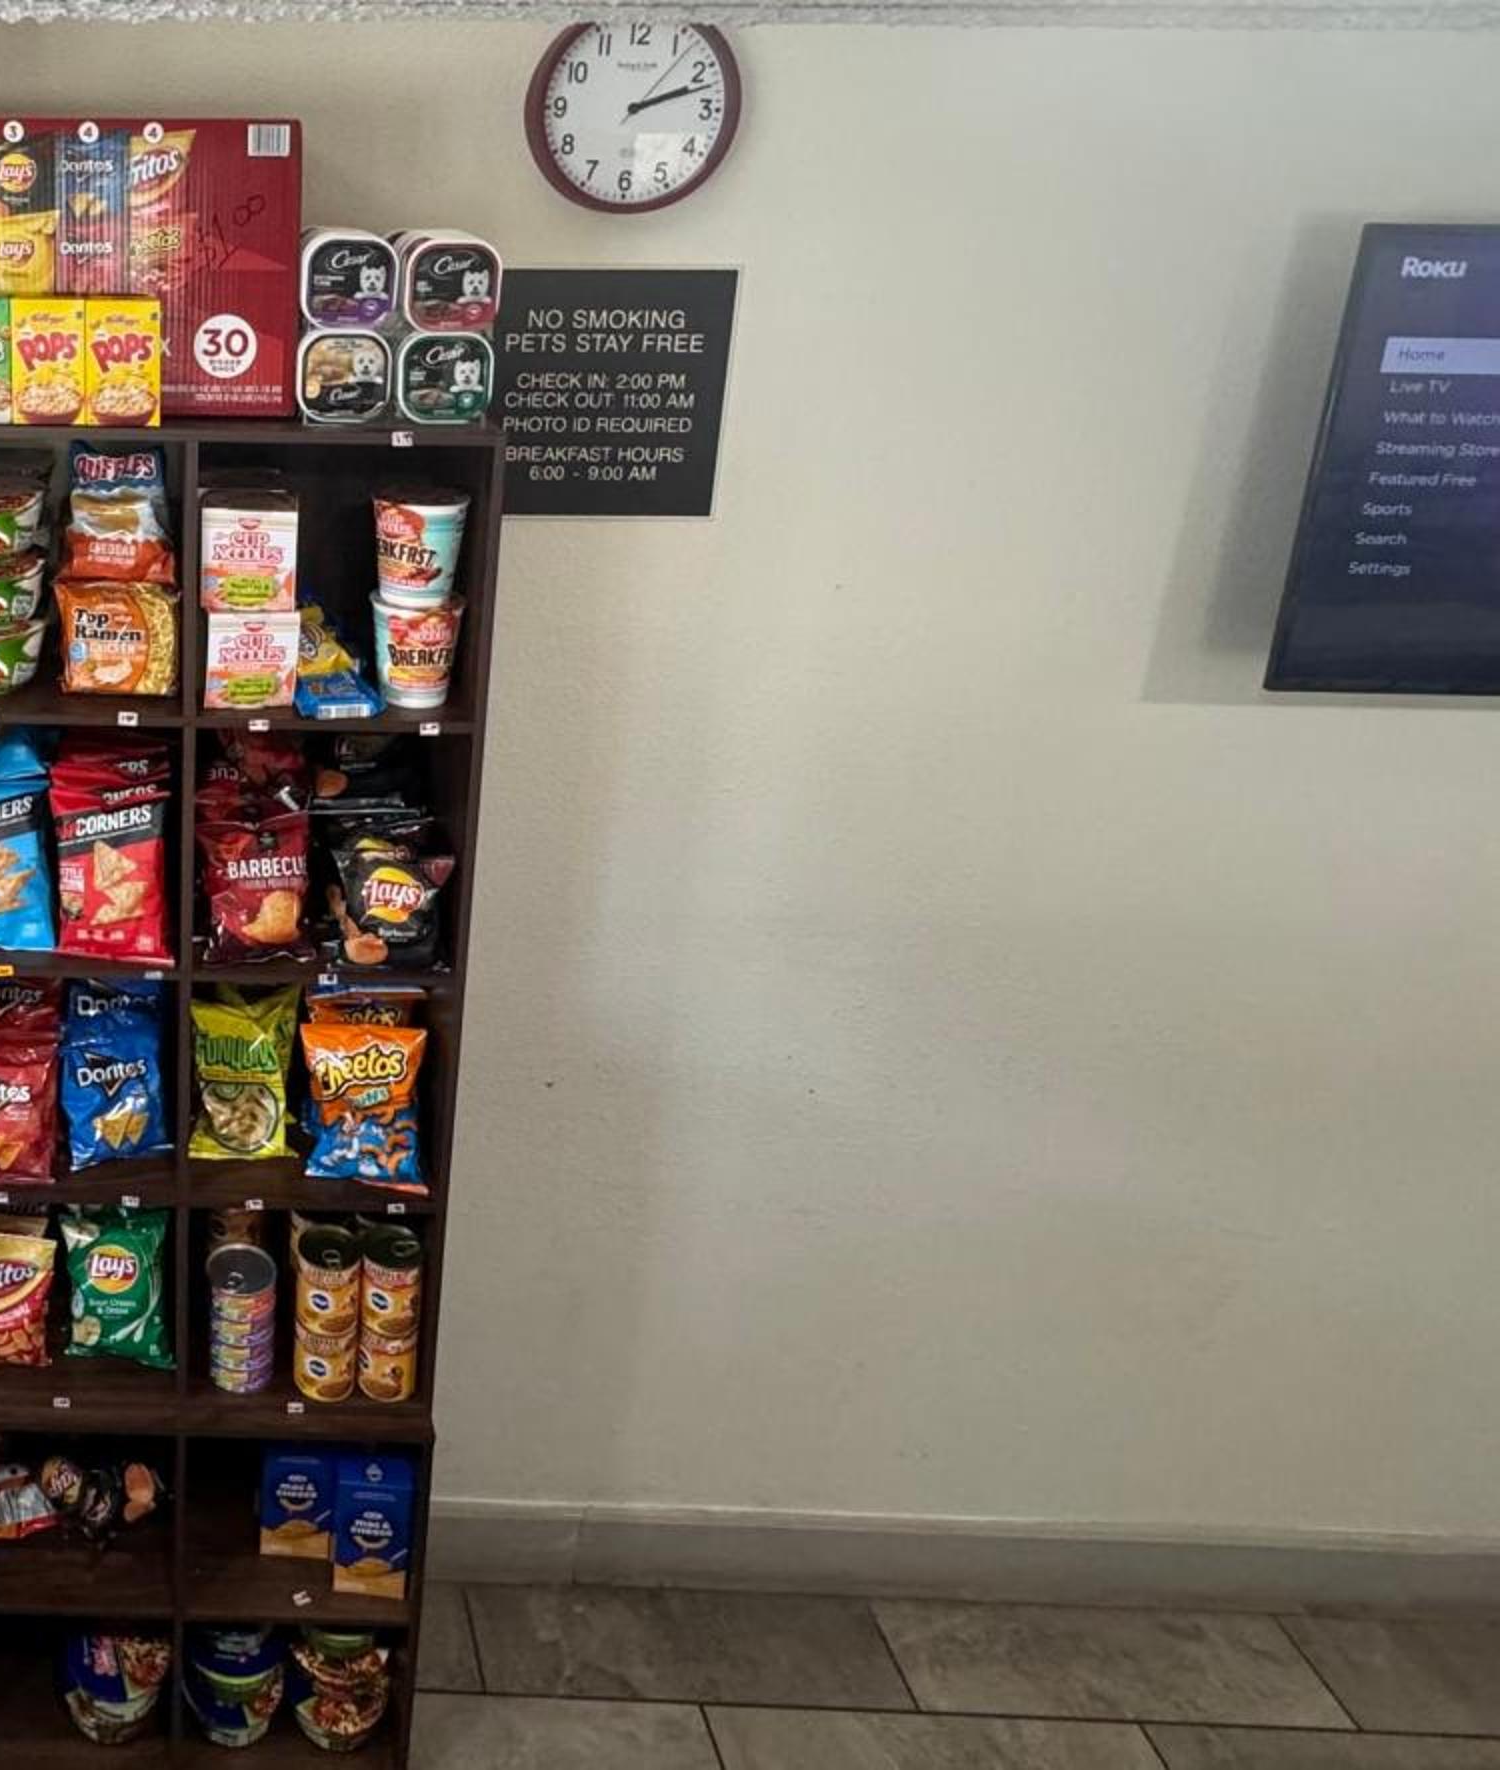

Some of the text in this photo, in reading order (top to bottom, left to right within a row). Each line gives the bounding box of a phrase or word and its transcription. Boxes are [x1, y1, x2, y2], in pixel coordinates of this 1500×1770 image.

[629, 23, 652, 46] 12
[598, 33, 612, 57] 11
[672, 34, 679, 57] 1
[567, 61, 588, 84] 10
[691, 61, 707, 83] 2
[553, 96, 567, 118] 9
[698, 99, 713, 121] 3
[9, 126, 18, 138] 3
[84, 126, 94, 138] 4
[148, 126, 158, 138] 4
[561, 133, 575, 155] 8
[682, 136, 696, 157] 4
[585, 159, 600, 181] 7
[653, 162, 668, 183] 5
[618, 170, 632, 191] 6
[528, 309, 686, 329] NO SMOKING
[17, 331, 78, 373] POPS
[202, 329, 249, 356] 30
[505, 333, 705, 353] PETS STAY FREE
[91, 332, 155, 374] POPS
[1398, 346, 1445, 362] Home
[517, 373, 582, 389] CHECK
[616, 374, 652, 389] 2:00
[657, 374, 686, 389] PM
[1389, 379, 1452, 393] Live TV
[504, 392, 569, 408] CHECK
[623, 394, 661, 408] 11:00
[665, 394, 695, 408] AM
[503, 417, 693, 433] PHOTO ID REQUIRED
[1384, 411, 1425, 424] What
[505, 446, 684, 462] BREAKFAST HOURS
[1376, 441, 1455, 458] Streaming
[529, 466, 564, 480] 6:00
[588, 466, 623, 480] 9:00
[627, 466, 657, 480] AM
[1368, 471, 1477, 487] Featured Free
[1363, 502, 1412, 517] Sports
[1354, 531, 1407, 545] Search
[1348, 561, 1411, 577] Settings
[75, 608, 109, 628] Top
[74, 624, 142, 642] Ramen
[76, 1058, 148, 1088] Doritos
[315, 1046, 405, 1094] Cheetos
[90, 1256, 135, 1281] Lay's
